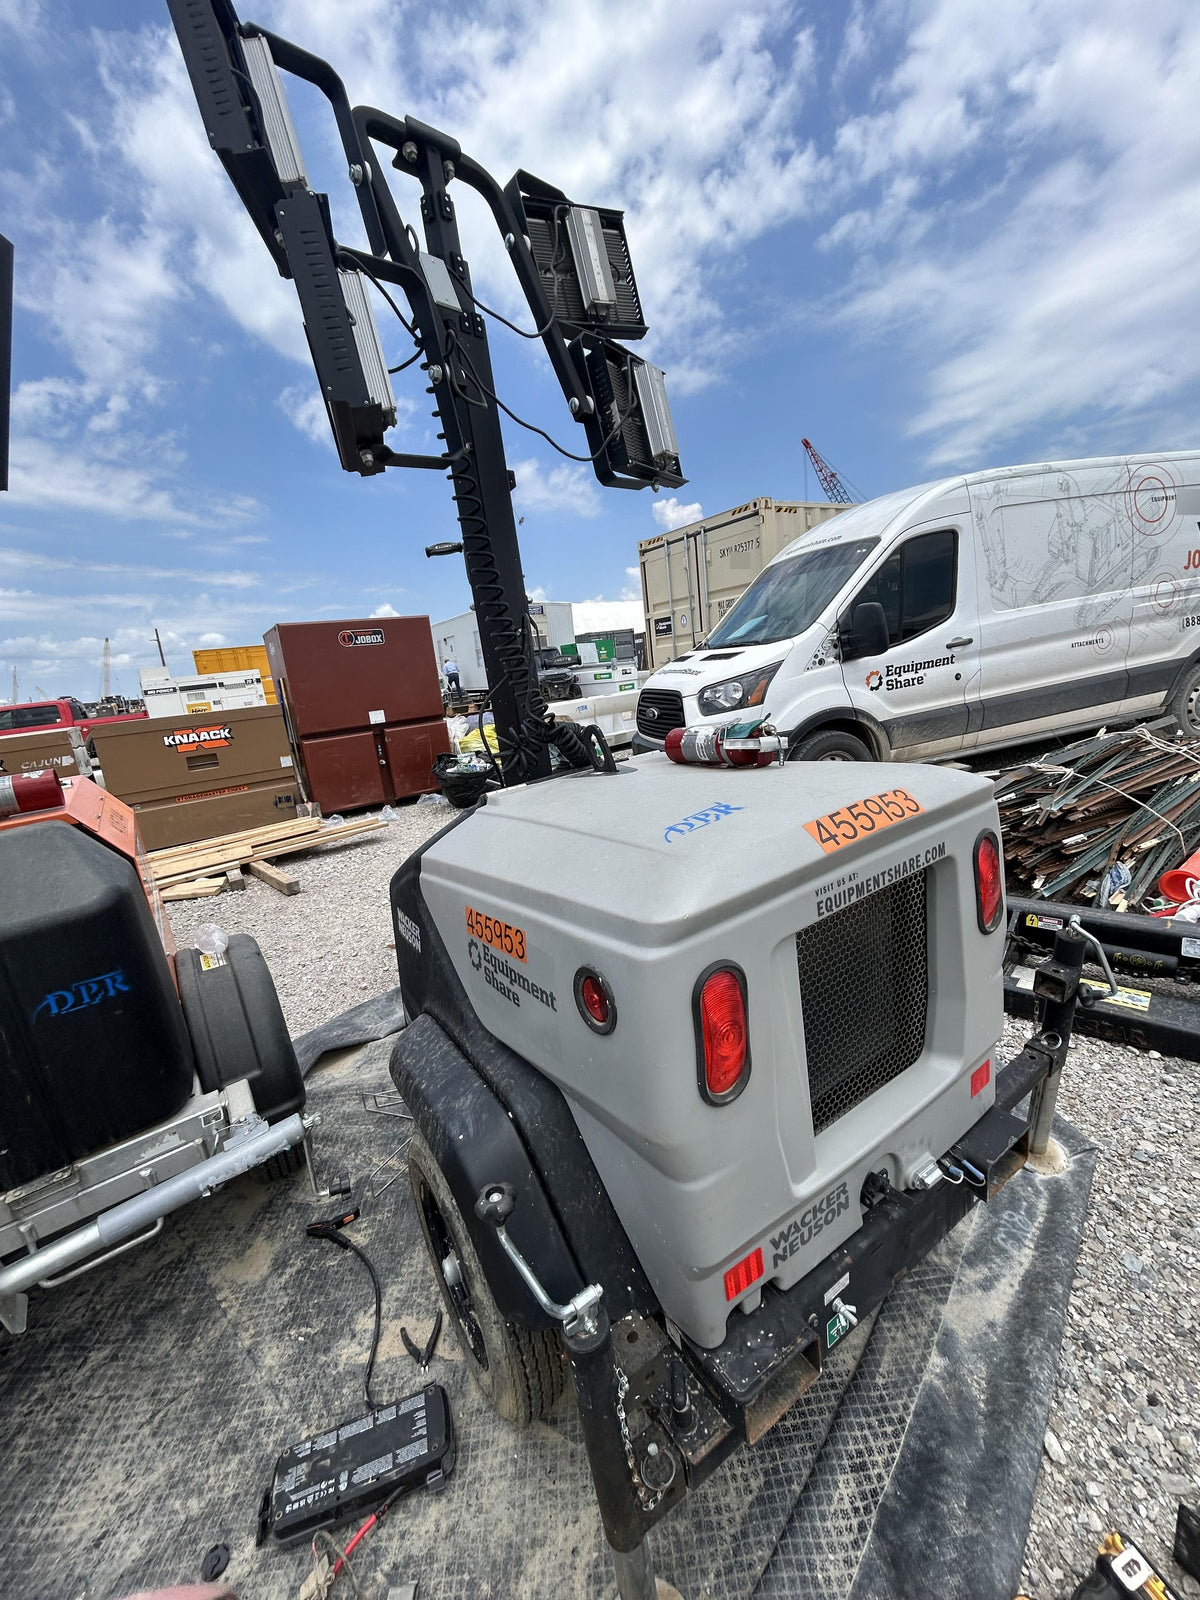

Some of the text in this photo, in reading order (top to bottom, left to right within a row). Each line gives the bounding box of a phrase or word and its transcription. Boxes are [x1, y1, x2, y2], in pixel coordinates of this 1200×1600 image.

[355, 634, 383, 644] JOBOX
[1071, 638, 1104, 648] ATTACHMENTS
[885, 654, 956, 677] Equipment
[885, 675, 925, 691] Share
[163, 728, 231, 746] KNAACK
[664, 801, 745, 843] DPR
[815, 788, 919, 847] 455953
[814, 882, 835, 897] VISIT
[836, 876, 846, 888] US
[816, 841, 946, 918] EQUIPMENTSHARE.COM
[466, 908, 526, 960] 455953
[32, 969, 130, 1024] DPR
[482, 943, 559, 1013] Equipment
[484, 965, 521, 1008] Share
[769, 1181, 849, 1251] WACKER
[772, 1194, 850, 1270] NEUSON
